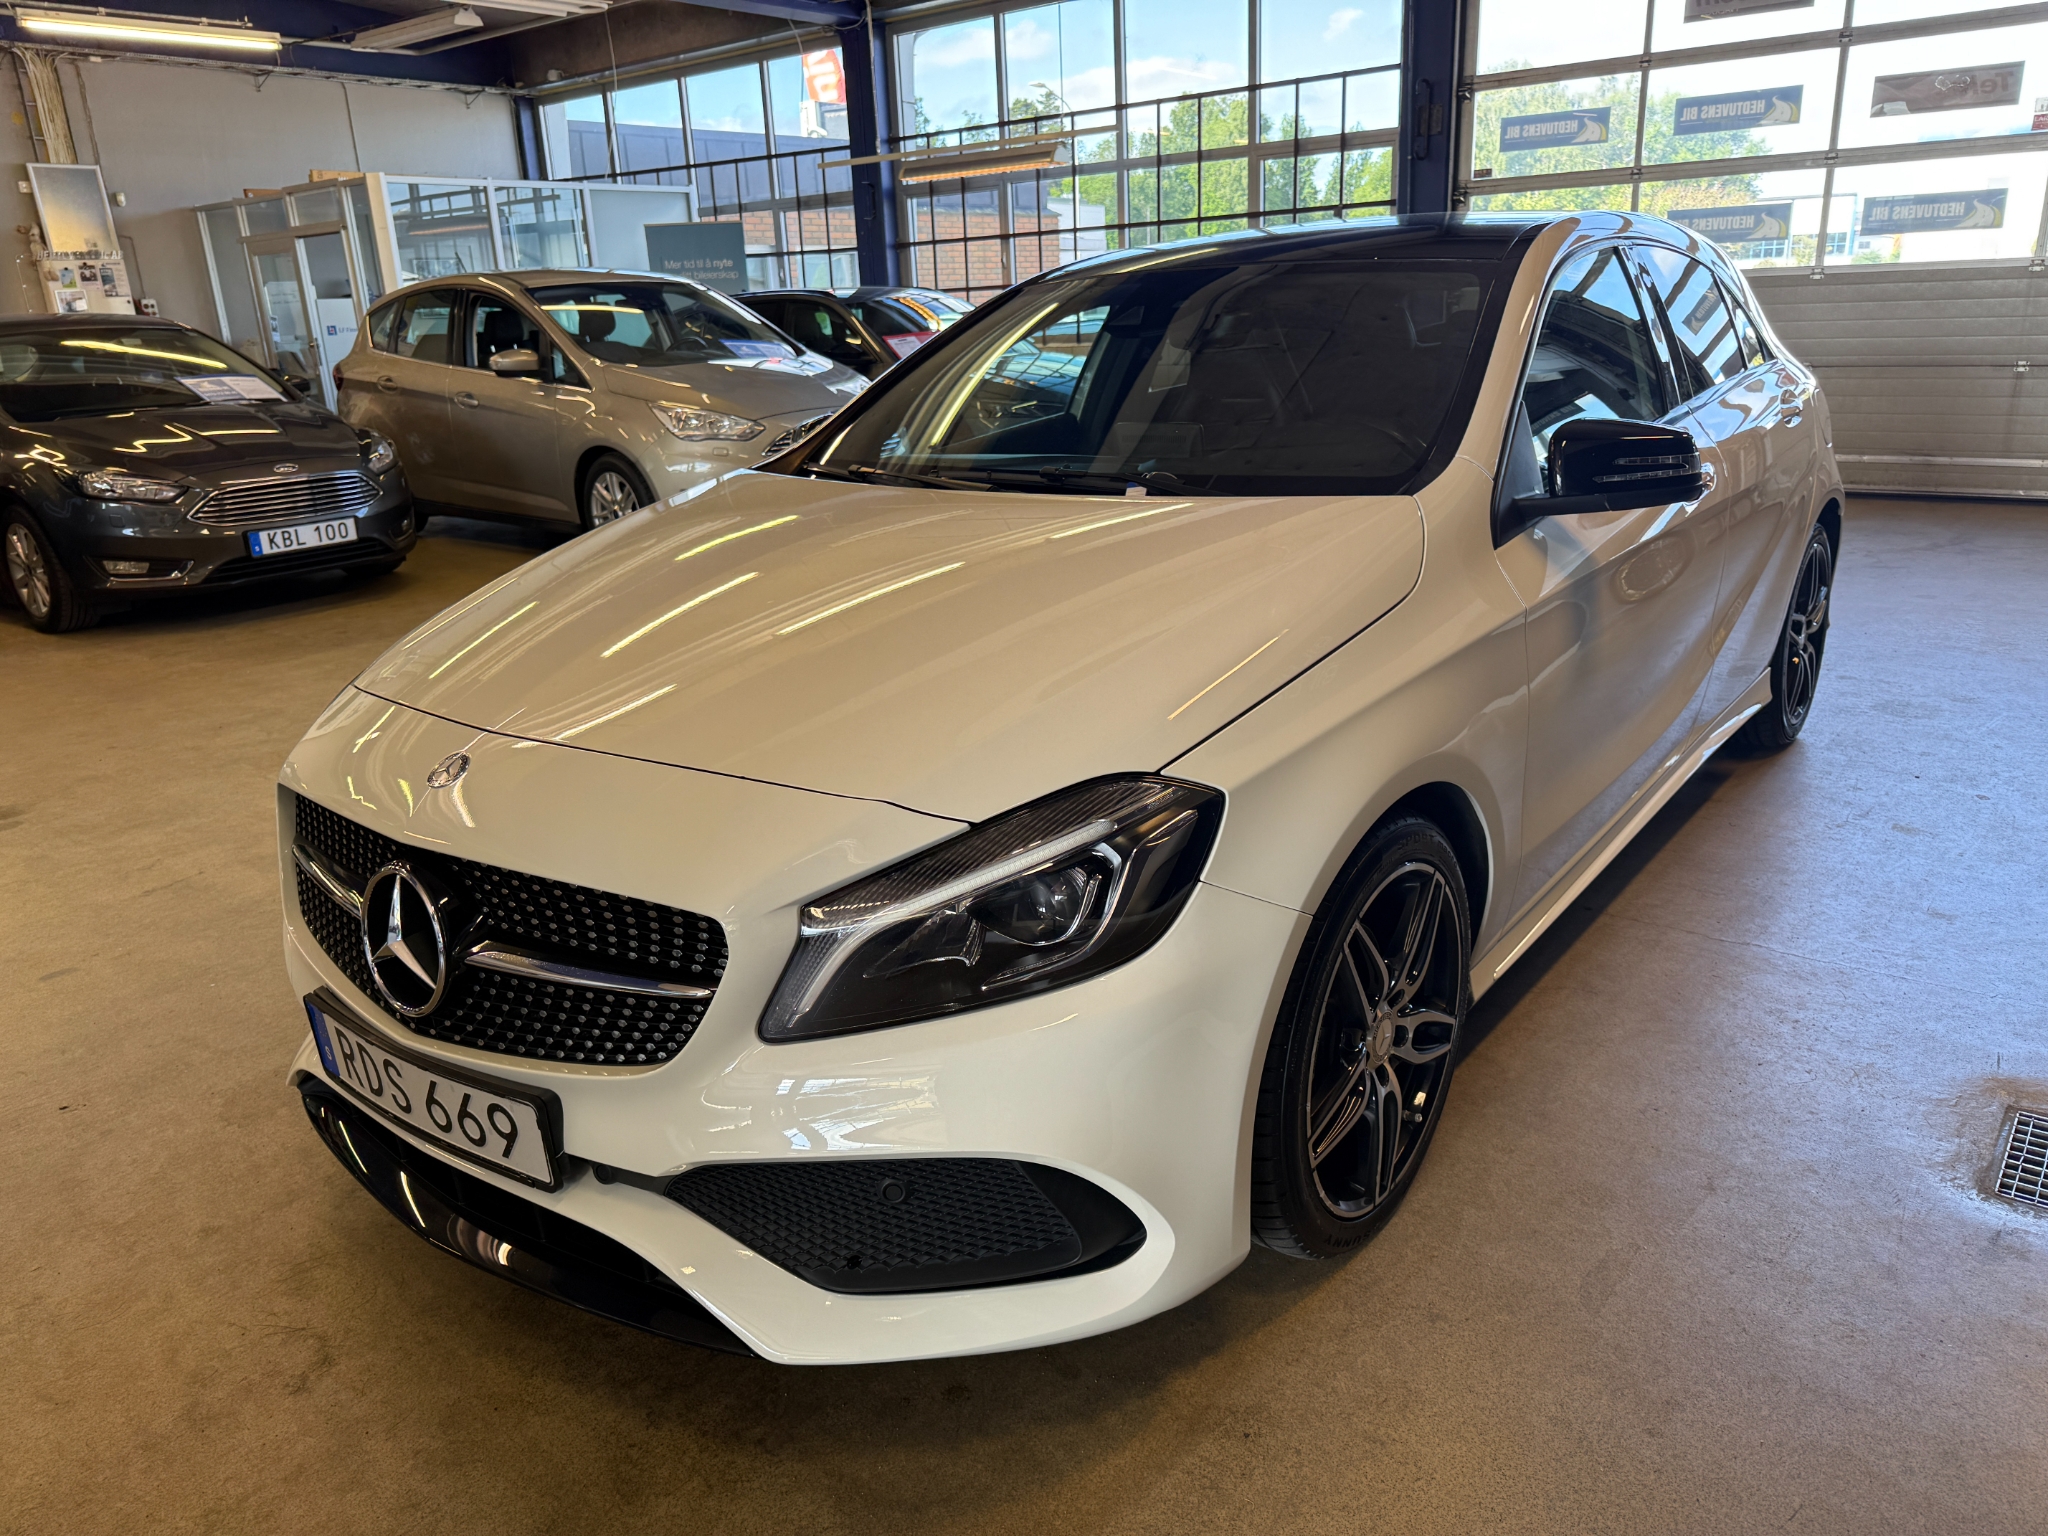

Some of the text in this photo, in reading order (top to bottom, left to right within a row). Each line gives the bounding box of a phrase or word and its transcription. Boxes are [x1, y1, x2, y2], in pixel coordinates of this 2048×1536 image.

[665, 260, 681, 269] Mer
[684, 259, 695, 268] tid
[713, 258, 733, 270] nyte
[267, 522, 349, 550] KBL 100
[334, 1026, 518, 1159] RDS 669
